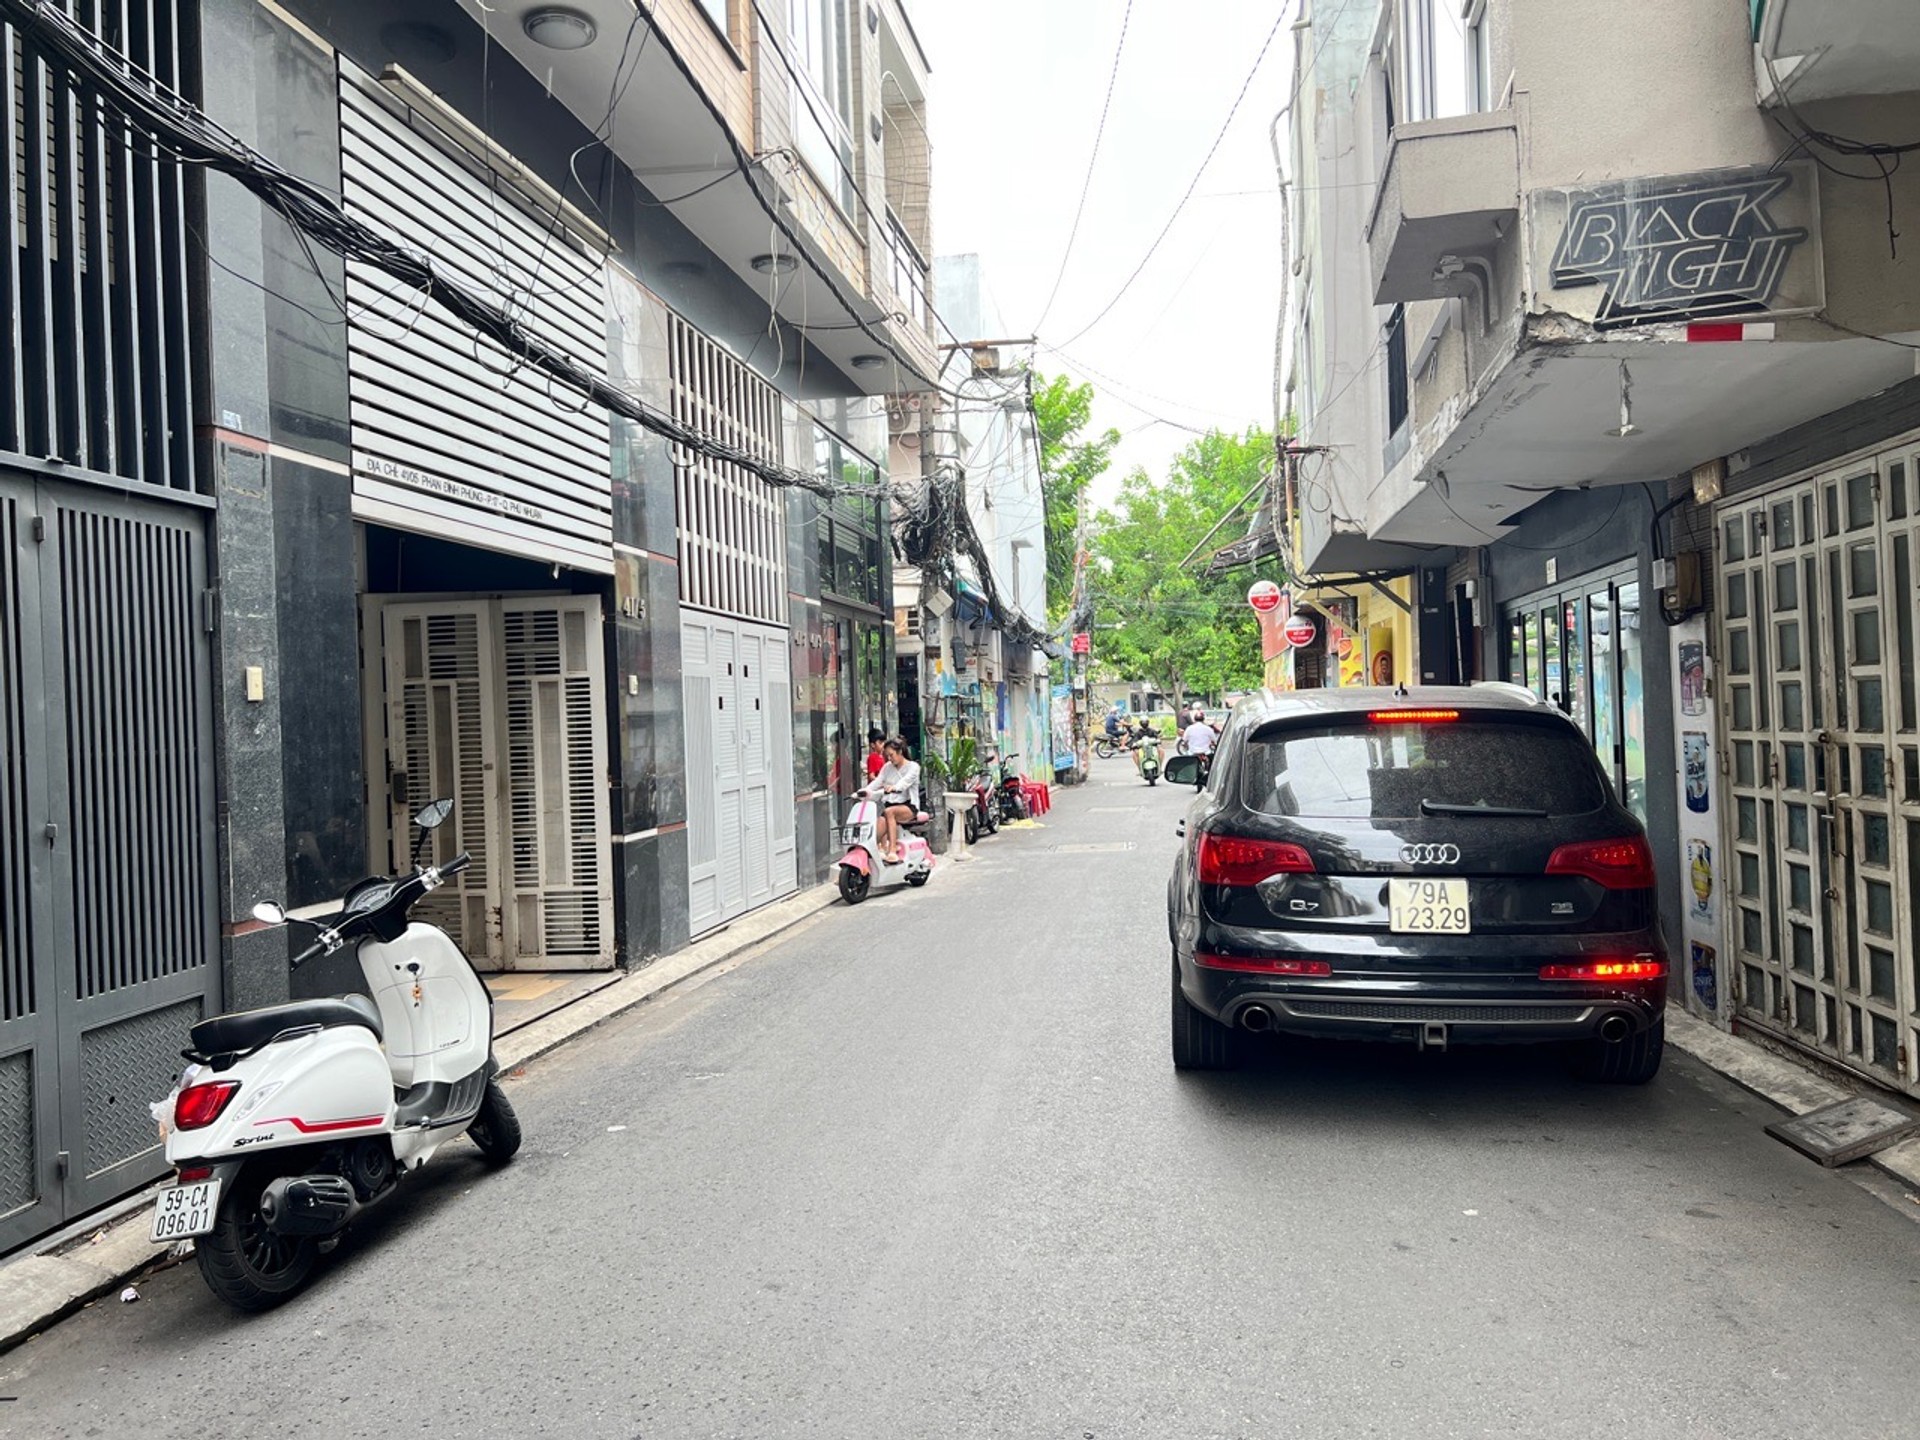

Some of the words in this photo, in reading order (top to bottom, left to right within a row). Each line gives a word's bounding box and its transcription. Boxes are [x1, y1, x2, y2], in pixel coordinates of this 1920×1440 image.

[1560, 177, 1787, 267] BLACK
[1408, 882, 1449, 904] 79A
[1290, 899, 1319, 911] Q7
[1395, 907, 1467, 930] 123.29
[233, 1133, 275, 1147] Sprint
[165, 1185, 208, 1211] 59-CA
[156, 1208, 208, 1237] 096.01
